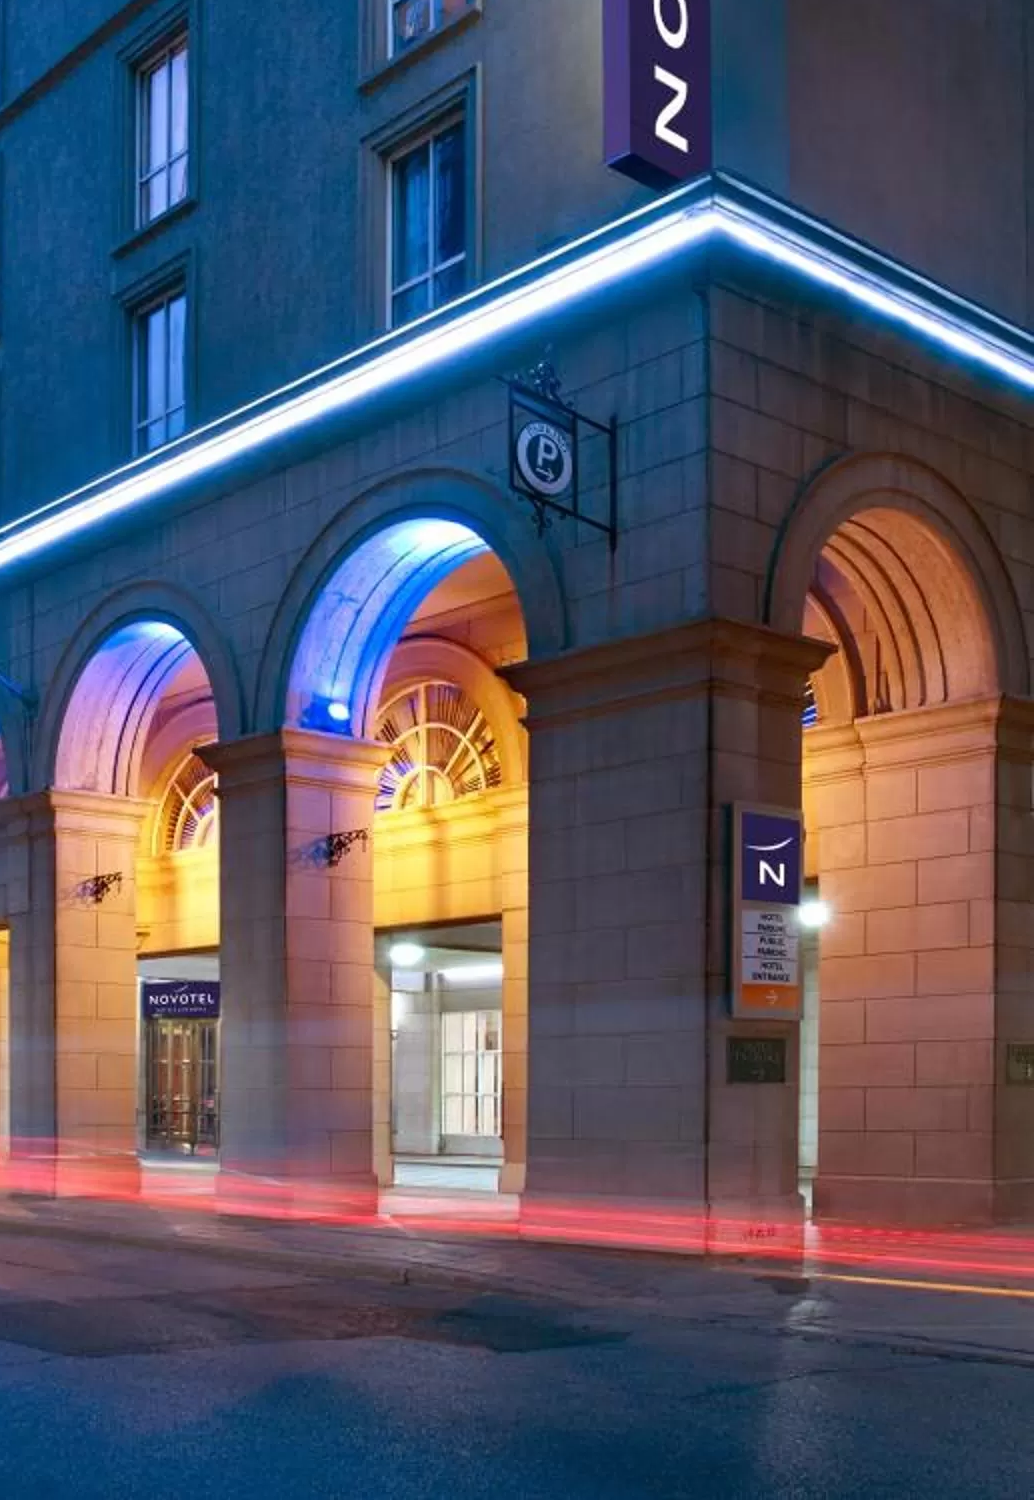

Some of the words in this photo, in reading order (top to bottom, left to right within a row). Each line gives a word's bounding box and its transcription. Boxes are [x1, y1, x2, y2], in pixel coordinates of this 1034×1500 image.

[537, 436, 558, 467] P
[759, 860, 785, 887] N
[149, 993, 215, 1004] NOVOTEL
